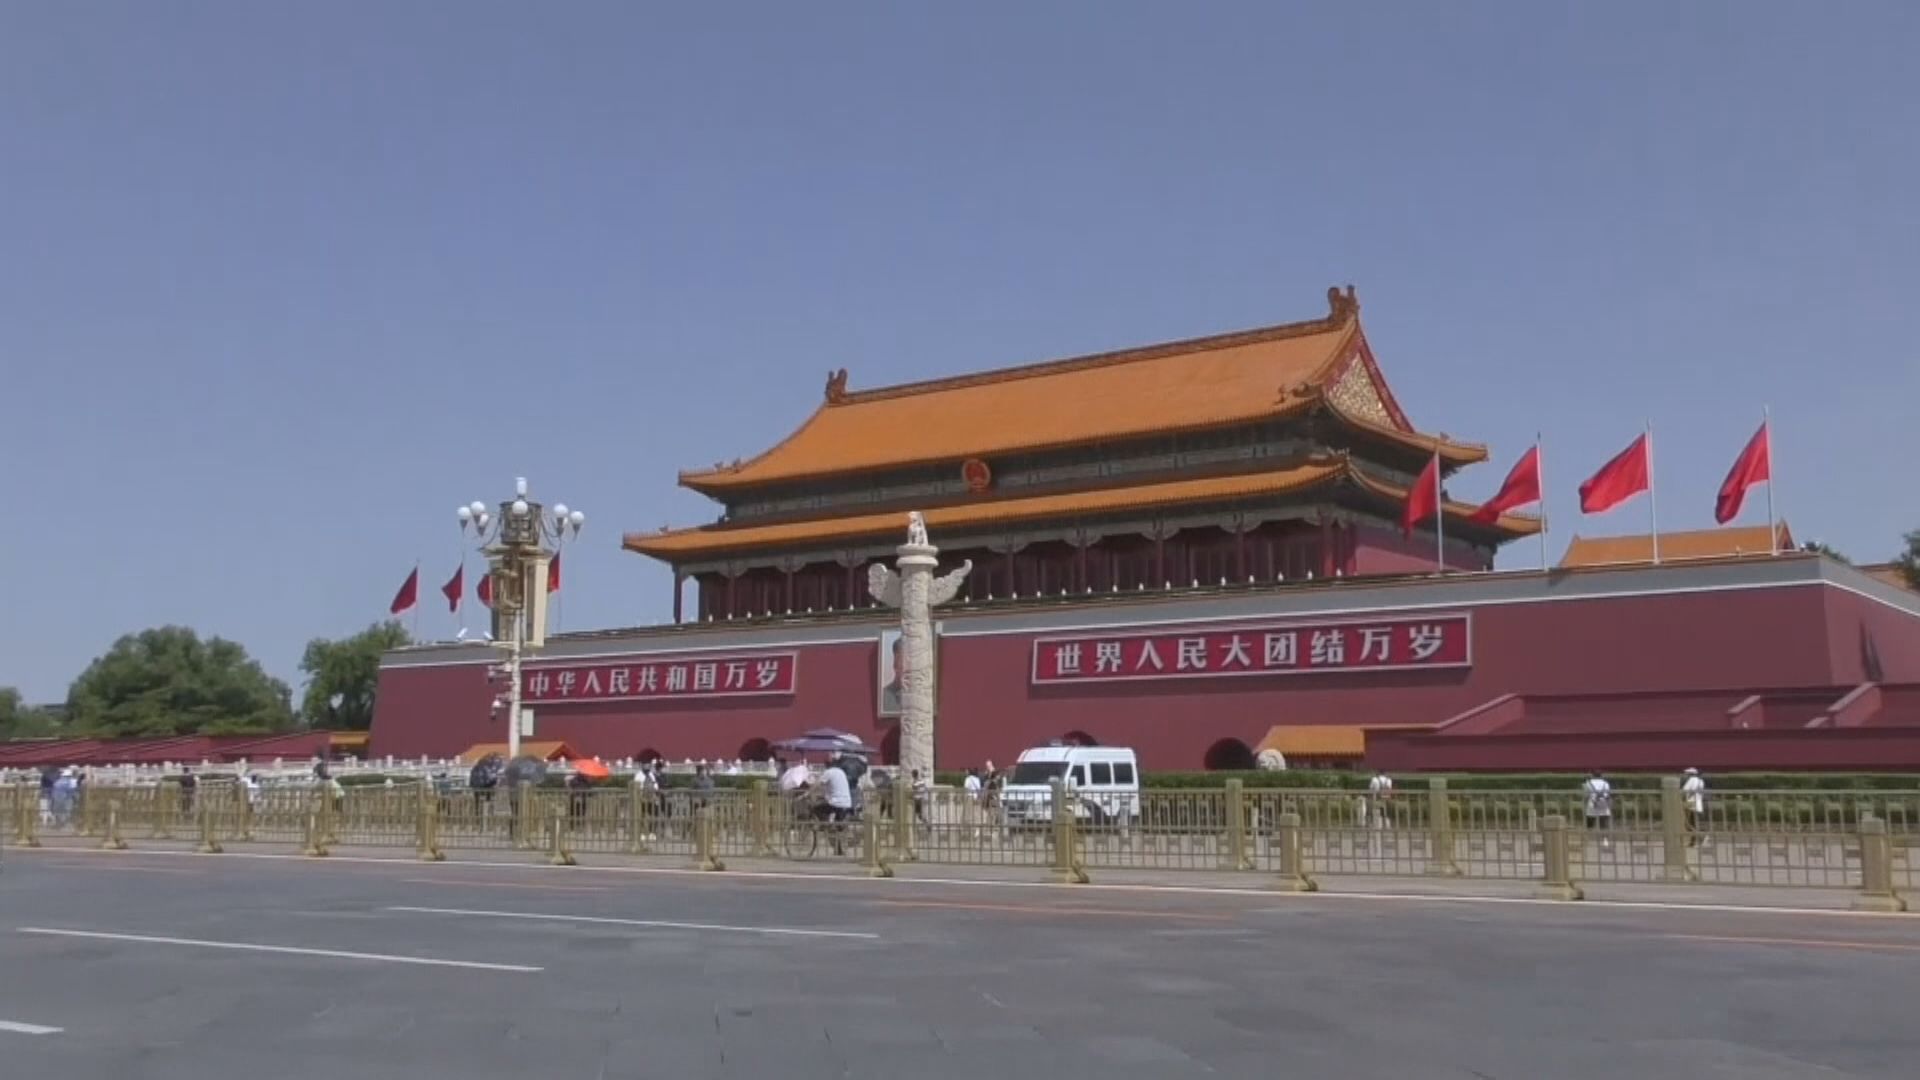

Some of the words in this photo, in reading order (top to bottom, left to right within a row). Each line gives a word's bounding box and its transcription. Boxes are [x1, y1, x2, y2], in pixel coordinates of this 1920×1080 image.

[1055, 625, 1443, 675] 世界人民大团结万岁
[529, 660, 778, 697] 中华人民共和国万岁
